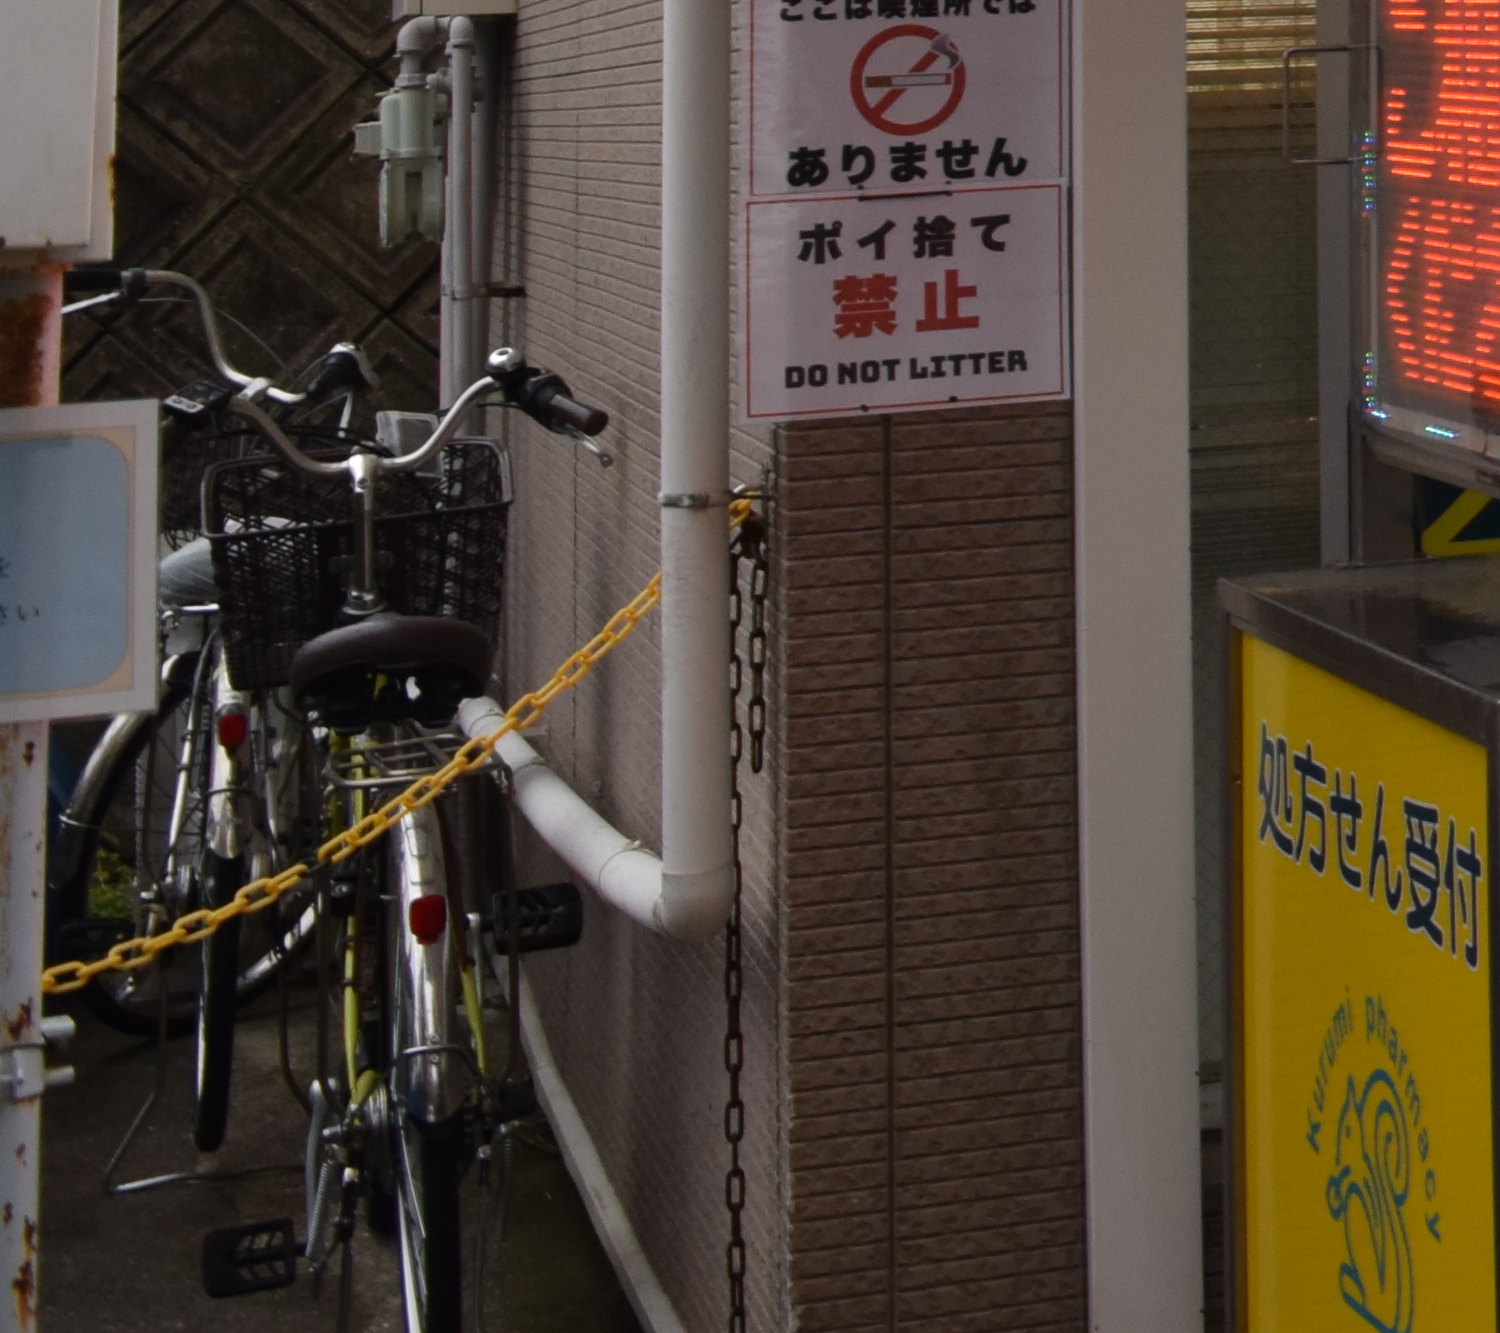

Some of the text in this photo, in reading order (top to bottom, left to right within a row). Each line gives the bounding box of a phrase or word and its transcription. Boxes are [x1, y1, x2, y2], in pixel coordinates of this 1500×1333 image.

[787, 137, 1028, 188] ありません
[798, 214, 1011, 265] ポイ捨て
[833, 268, 980, 339] 禁止
[785, 349, 1028, 389] DO NOT LITTER
[1256, 722, 1482, 973] 処方せん受付
[1306, 985, 1442, 1244] Kurumi pharmacy
